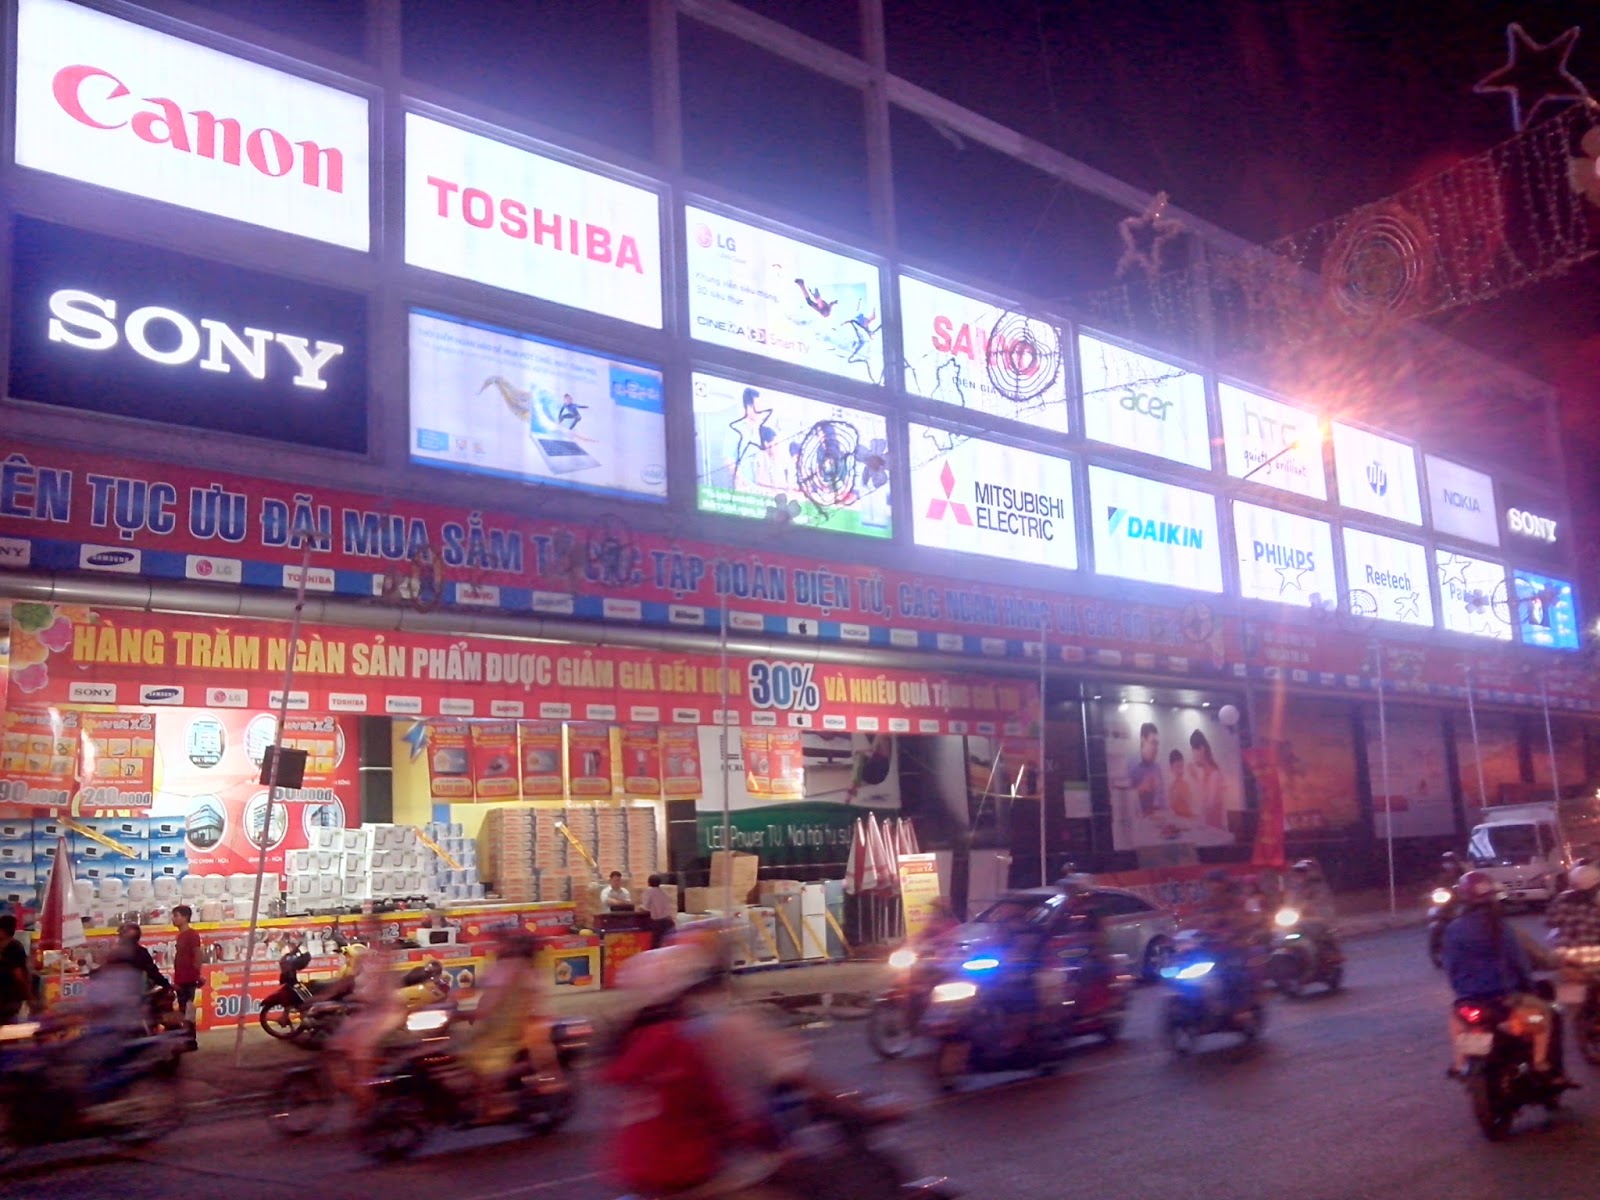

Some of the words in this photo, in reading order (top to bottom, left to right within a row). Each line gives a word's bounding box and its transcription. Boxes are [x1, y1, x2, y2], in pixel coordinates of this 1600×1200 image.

[52, 64, 344, 194] Canon
[427, 175, 645, 275] TOSHIBA
[717, 233, 737, 252] LG
[48, 288, 344, 390] SONY
[1119, 387, 1173, 421] acer
[974, 481, 1065, 519] MITSUBISHI
[1443, 488, 1480, 513] NOKIA
[976, 507, 1054, 541] ELECTRIC
[1127, 515, 1203, 550] DAIKIN
[1507, 506, 1558, 543] SONY
[87, 473, 177, 540] TỤC
[189, 483, 248, 543] ƯU
[260, 493, 332, 553] ĐÃI
[342, 508, 434, 564] MUA
[441, 511, 524, 574] SẮM
[651, 545, 706, 600] TẬP
[793, 566, 850, 616] ĐIỆN
[215, 566, 233, 576] LG
[287, 572, 332, 585] TOHIBA
[1365, 564, 1412, 592] Reetech
[73, 619, 165, 665] HÀNG
[173, 627, 260, 669] TRĂM
[267, 633, 345, 675] NGÀN
[352, 634, 406, 677] SẢN
[412, 641, 483, 682] PHẨM
[486, 651, 551, 692] ĐƯỢC
[557, 649, 614, 688] GIẢM
[619, 657, 656, 690] GIÁ
[659, 658, 698, 693] ĐẾN
[749, 660, 820, 712] 30%
[824, 671, 848, 703] VÀ
[850, 674, 898, 705] NHIỀU
[900, 677, 931, 709] QUÀ
[74, 687, 113, 697] SONY
[229, 694, 241, 703] LG
[332, 698, 365, 707] TOSHIBA
